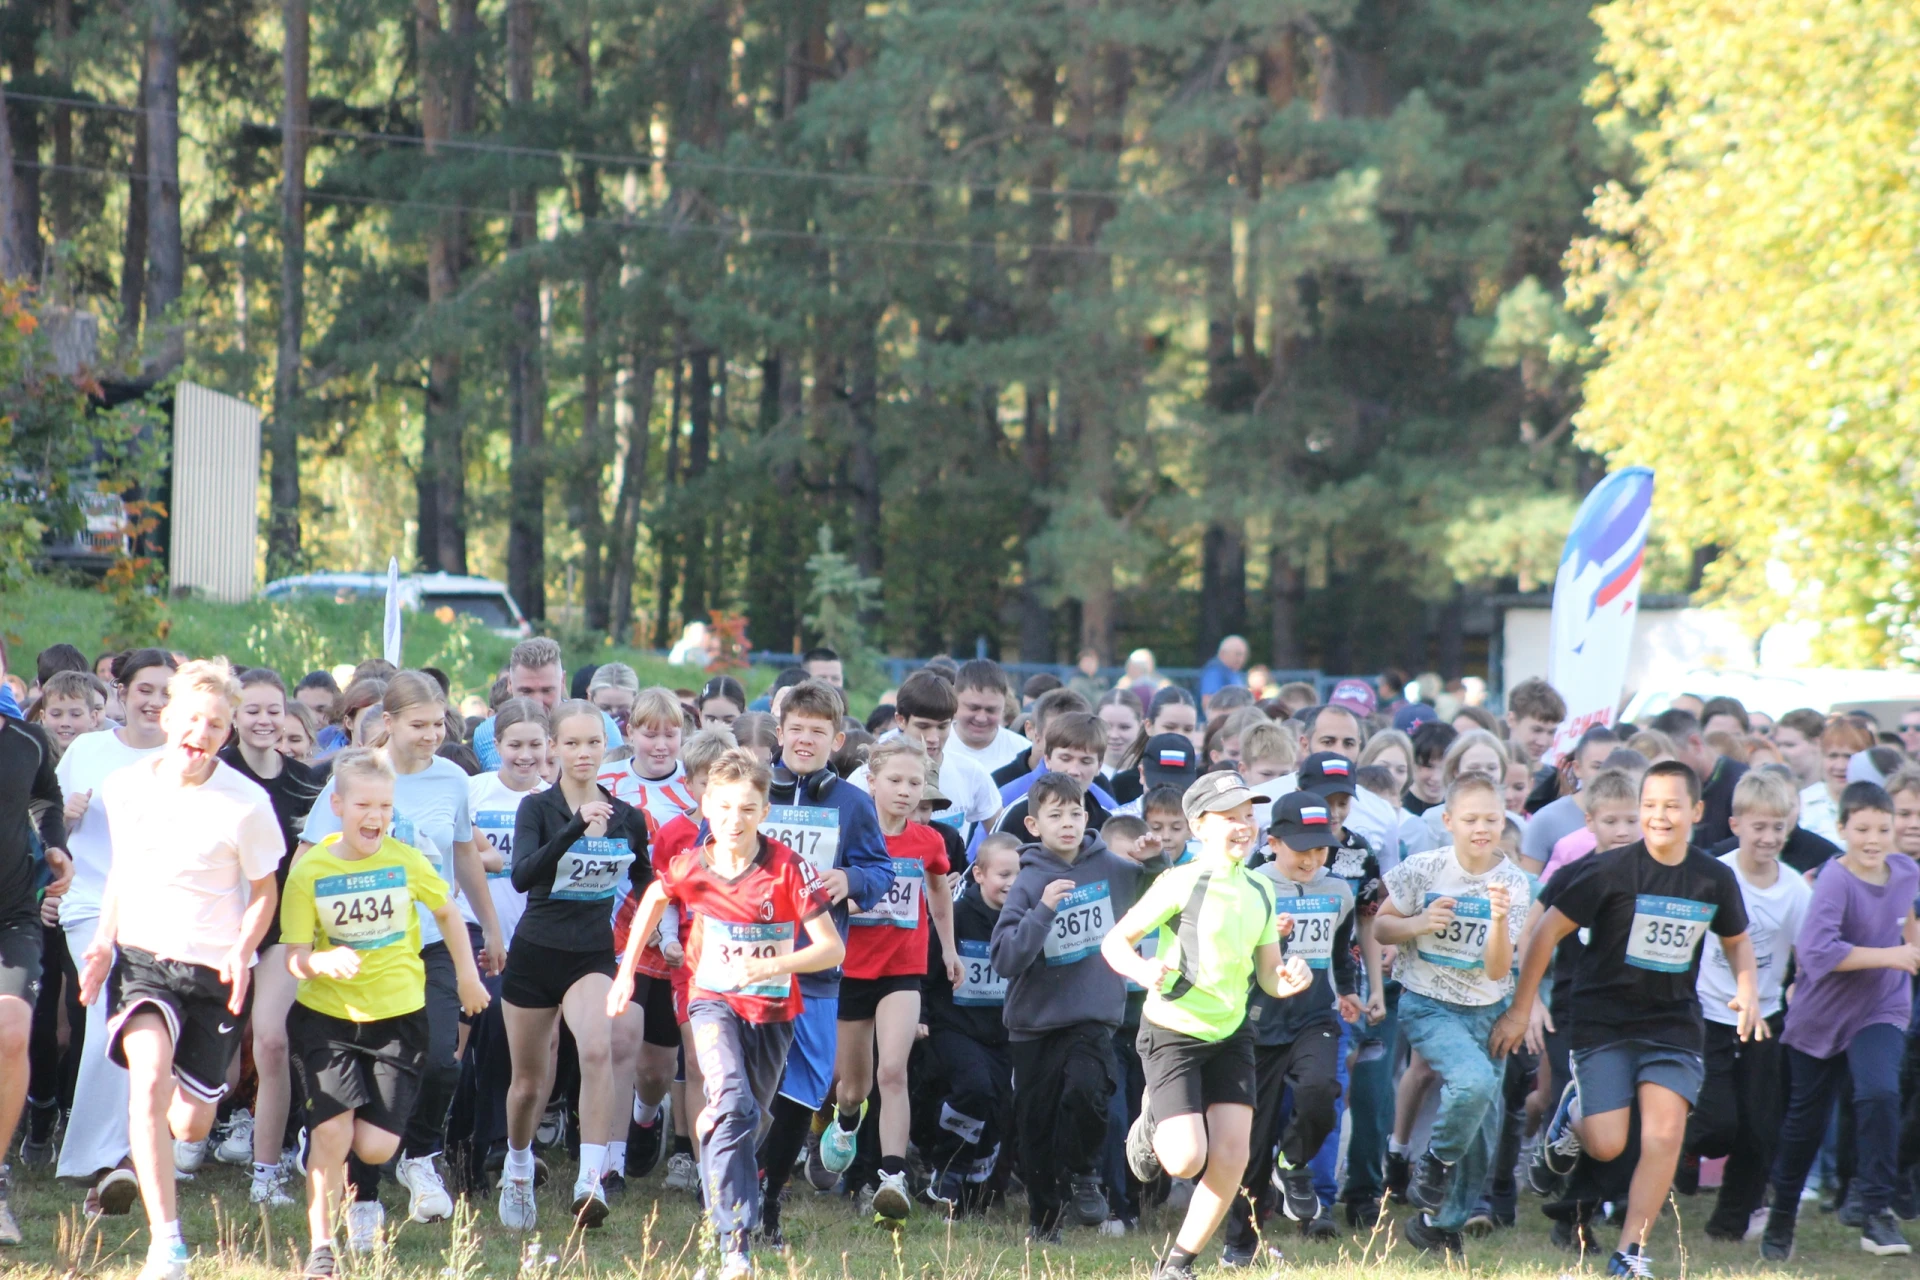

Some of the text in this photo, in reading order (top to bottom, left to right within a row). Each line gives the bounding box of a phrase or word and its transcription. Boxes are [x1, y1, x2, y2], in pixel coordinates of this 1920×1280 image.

[783, 809, 810, 818] КРОСС
[486, 833, 515, 855] 24
[587, 841, 611, 849] КРОС
[346, 875, 376, 886] КРОСС
[879, 882, 912, 905] 64
[1296, 897, 1320, 906] КРОСС
[333, 894, 394, 926] 2434
[1665, 902, 1692, 911] КРОСС
[1056, 906, 1102, 938] 3678
[732, 926, 762, 935] КРОСС
[1645, 921, 1695, 948] 3552
[969, 963, 1000, 984] 31
